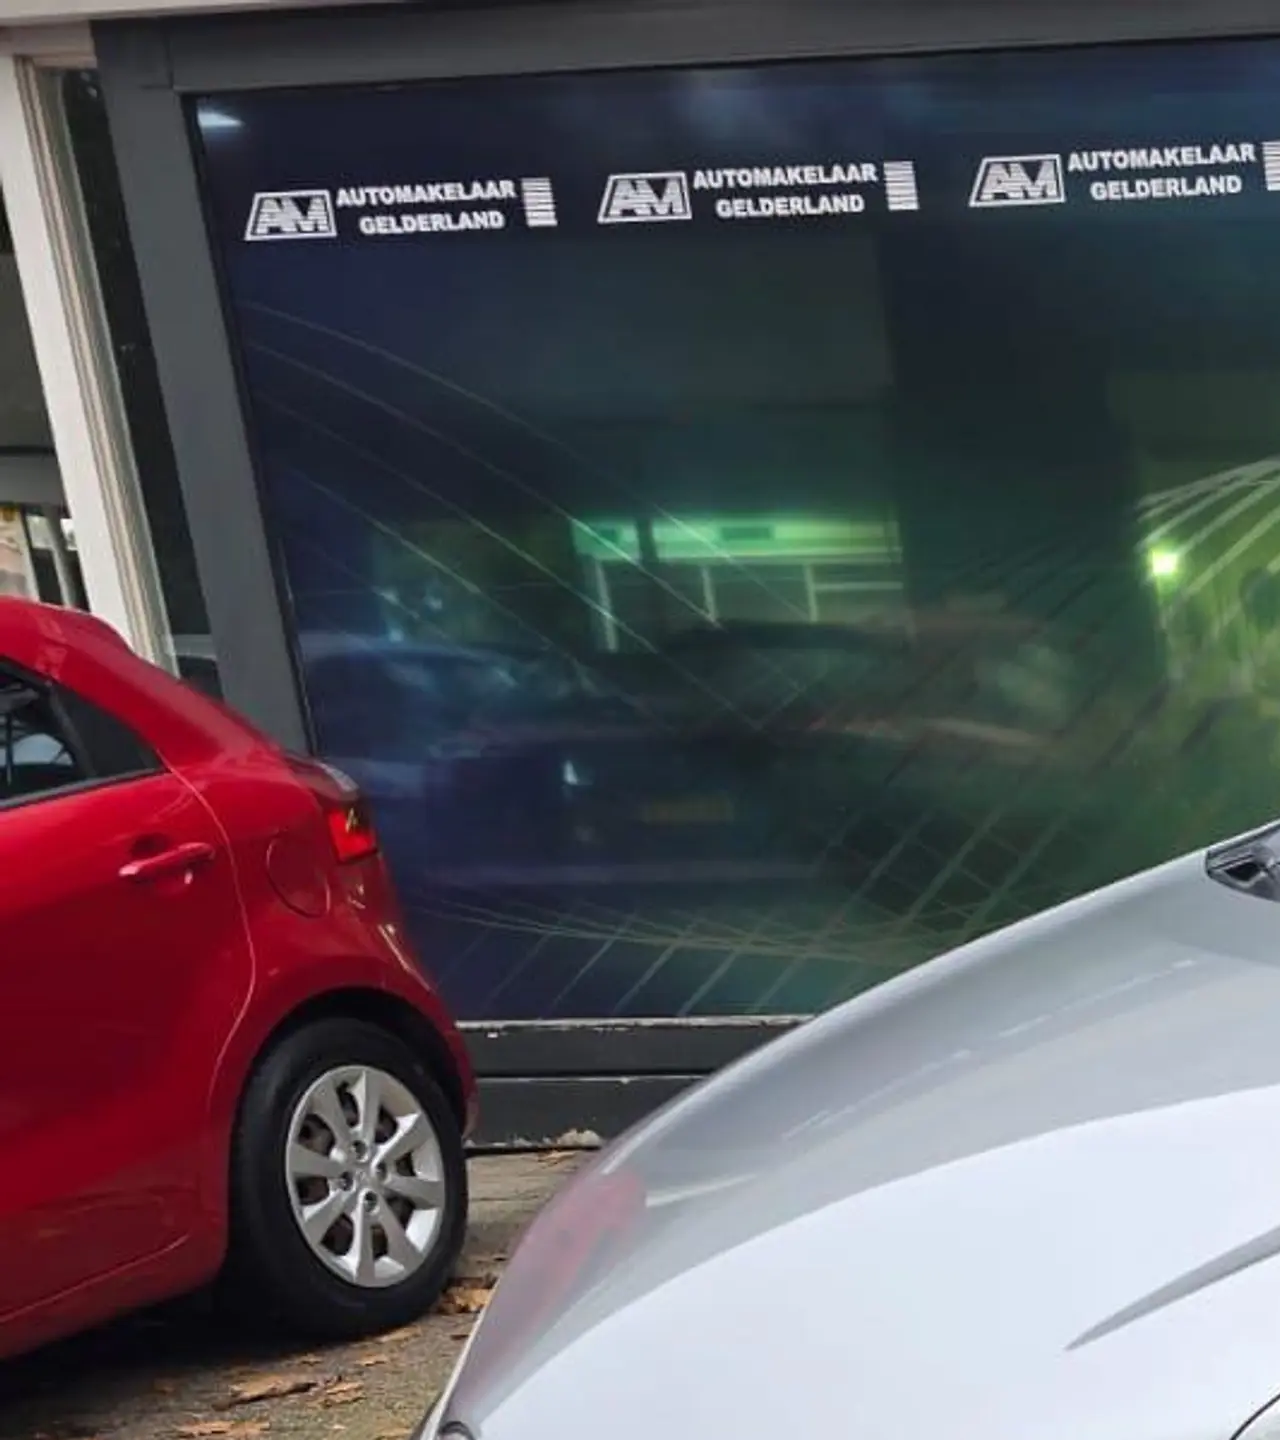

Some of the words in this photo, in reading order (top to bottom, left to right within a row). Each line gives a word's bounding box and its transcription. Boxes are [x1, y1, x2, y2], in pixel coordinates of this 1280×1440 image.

[1067, 142, 1256, 173] AUTOMAKELAAR
[693, 162, 878, 190] AUTOMAKELAAR
[1089, 175, 1242, 201] GELDERLAND
[335, 179, 517, 208] AUTOMAKELAAR
[715, 194, 865, 219] GELDERLAND
[358, 210, 505, 235] GELDERLAND
